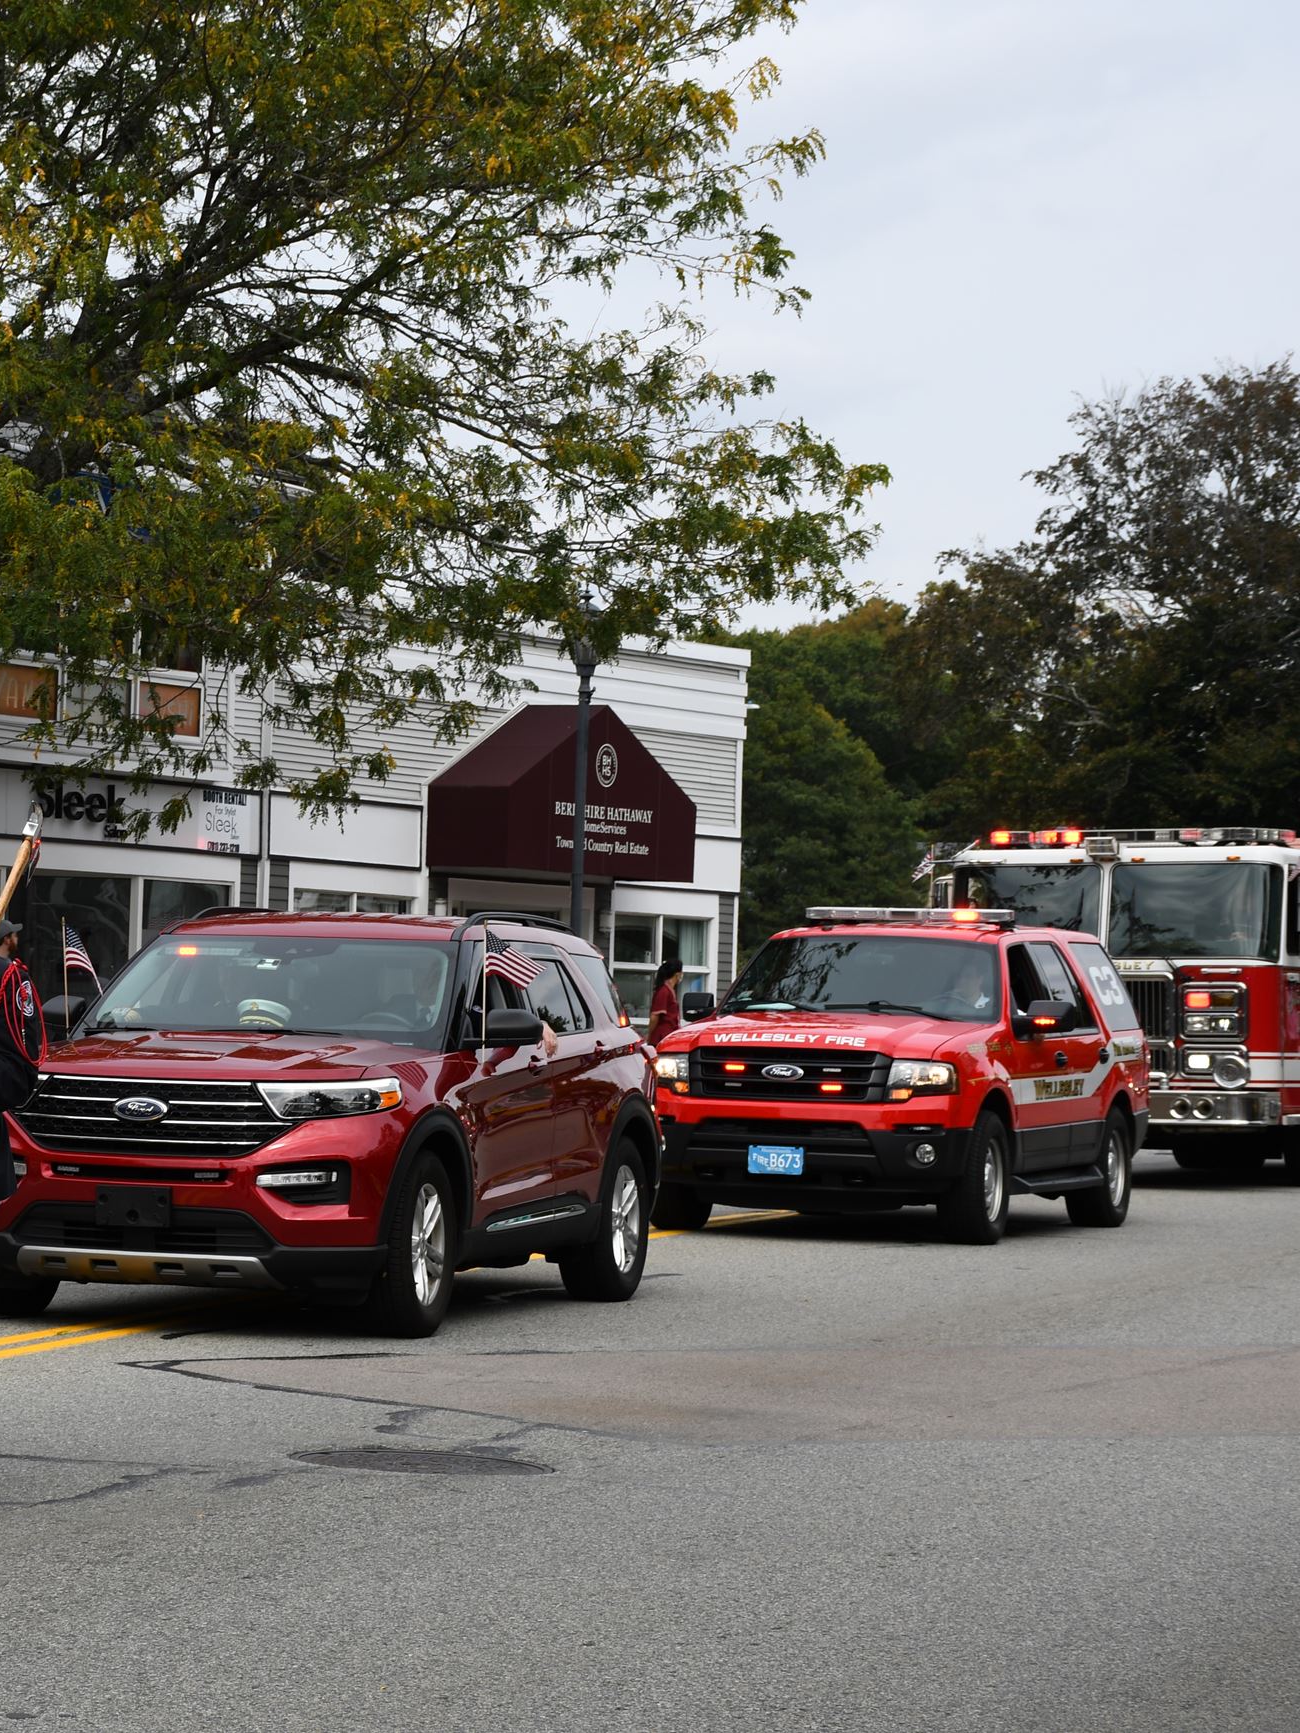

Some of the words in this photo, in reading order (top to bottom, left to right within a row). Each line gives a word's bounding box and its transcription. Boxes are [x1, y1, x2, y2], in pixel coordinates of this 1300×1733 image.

[205, 811, 237, 834] Sleek
[555, 801, 606, 820] BERHIRE
[607, 807, 654, 823] HATHAWAY
[556, 836, 574, 849] Town
[588, 838, 614, 856] Country
[614, 841, 629, 854] Real
[629, 843, 650, 856] Estate
[1088, 966, 1125, 1006] C3
[714, 1033, 821, 1043] WELLESLEY
[825, 1035, 867, 1047] FIRE
[770, 1153, 800, 1168] B673
